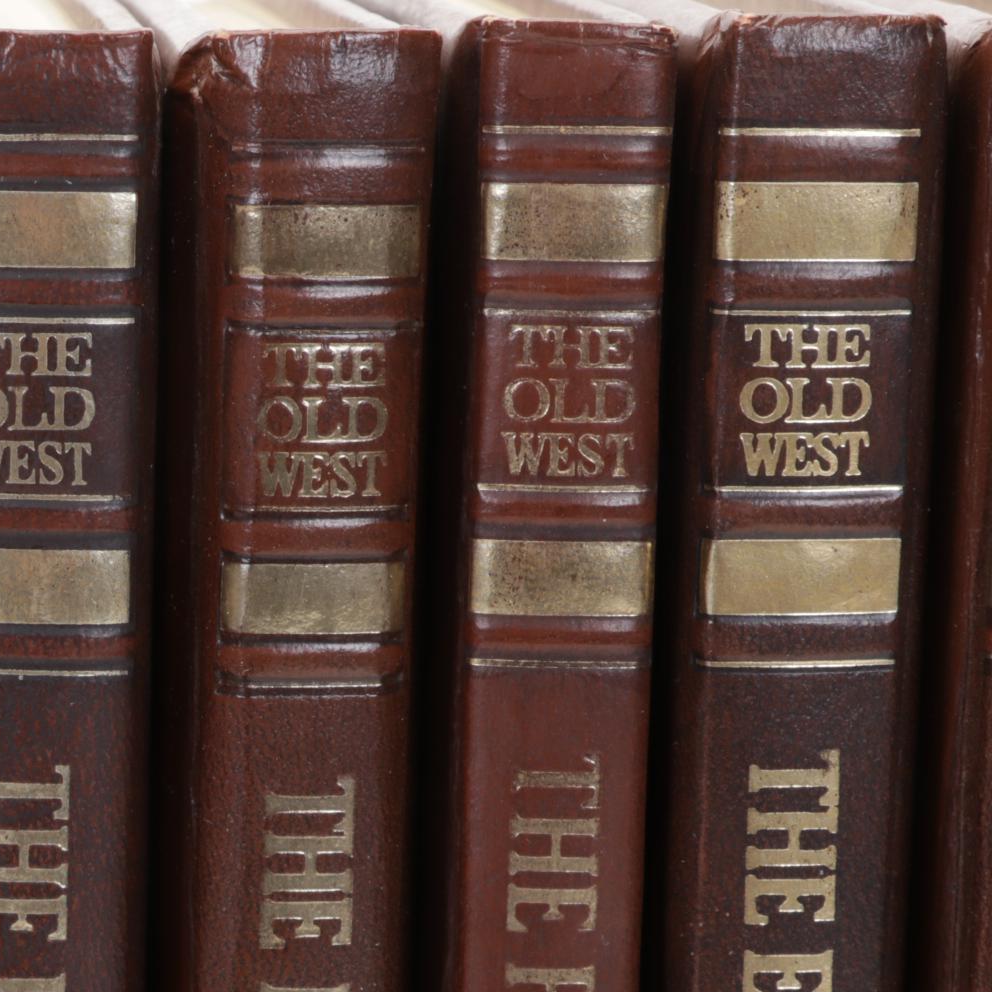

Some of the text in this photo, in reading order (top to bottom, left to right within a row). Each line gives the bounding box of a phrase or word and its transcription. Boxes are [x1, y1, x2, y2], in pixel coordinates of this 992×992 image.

[263, 342, 386, 389] THE
[512, 324, 635, 369] THE
[745, 324, 871, 368] THE
[257, 397, 388, 443] OLD
[504, 377, 637, 424] OLD
[740, 377, 873, 424] OLD
[258, 451, 387, 499] WEST
[504, 432, 635, 478] WEST
[740, 432, 870, 478] WEST
[505, 753, 601, 935] THE
[744, 748, 841, 926] THE
[257, 775, 356, 950] THE
